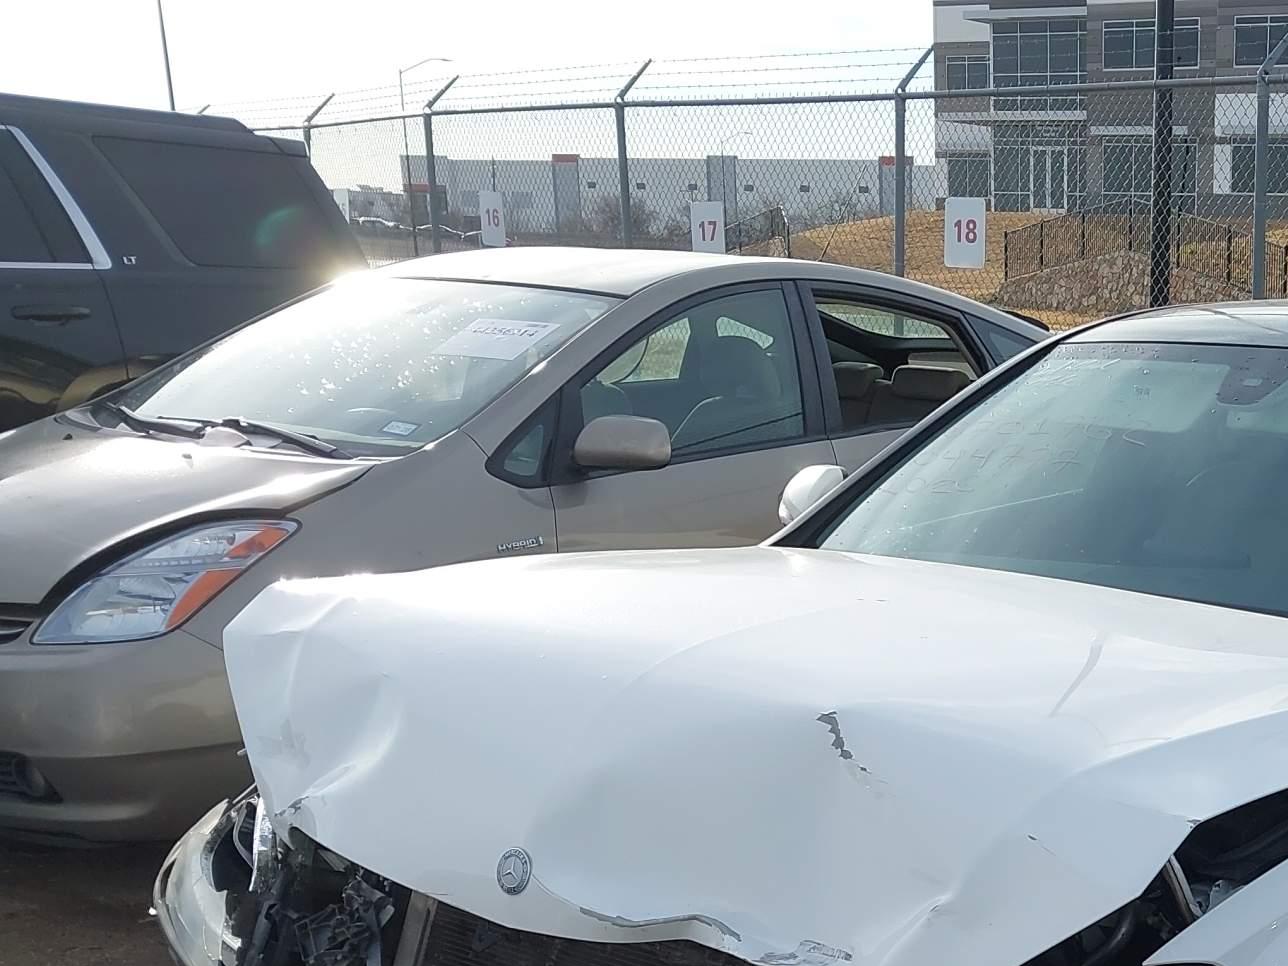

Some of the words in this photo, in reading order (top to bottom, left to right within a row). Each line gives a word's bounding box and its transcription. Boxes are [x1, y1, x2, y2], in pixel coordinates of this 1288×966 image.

[485, 208, 500, 227] 16
[698, 220, 717, 242] 17
[953, 219, 978, 244] 18
[122, 256, 137, 265] LT
[496, 538, 537, 552] HYBRID
